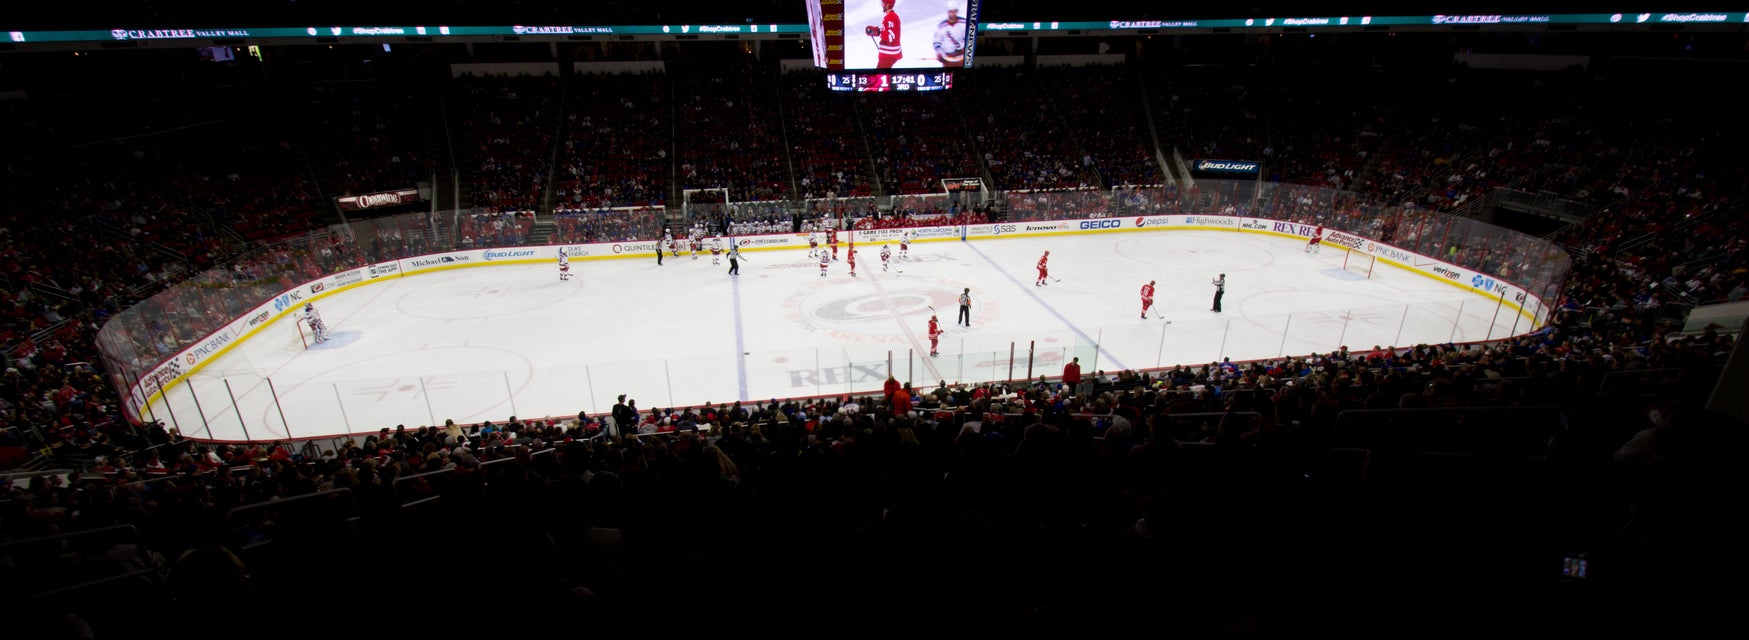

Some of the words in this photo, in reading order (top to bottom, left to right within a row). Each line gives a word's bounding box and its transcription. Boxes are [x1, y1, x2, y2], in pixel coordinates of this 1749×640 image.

[1446, 15, 1501, 24] CRABTREE
[1661, 14, 1727, 23] #ShopCrabtree
[128, 29, 195, 39] CRABTREE
[352, 27, 405, 35] #ShopCrabtree
[525, 26, 574, 34] CRABTREE
[699, 25, 740, 33] #ShopCrabtree
[880, 75, 889, 87] 1
[891, 75, 915, 84] 17:41
[917, 74, 925, 86] 0
[1225, 163, 1257, 171] LIGHT
[359, 192, 399, 209] Cheerwine
[1080, 219, 1121, 230] GEICO
[1145, 216, 1169, 226] pepsi
[1001, 224, 1017, 233] sas
[1273, 222, 1297, 235] REX
[1330, 231, 1355, 243] Advance
[487, 251, 507, 259] BUD
[1376, 245, 1390, 257] PNC
[1391, 249, 1410, 262] BANK
[411, 257, 441, 268] Michael
[454, 254, 469, 262] Son
[1432, 264, 1460, 279] verizon
[290, 290, 303, 302] NC
[249, 311, 270, 326] verizon
[194, 342, 212, 360] PNC
[211, 333, 231, 350] BANK
[784, 363, 889, 388] REX
